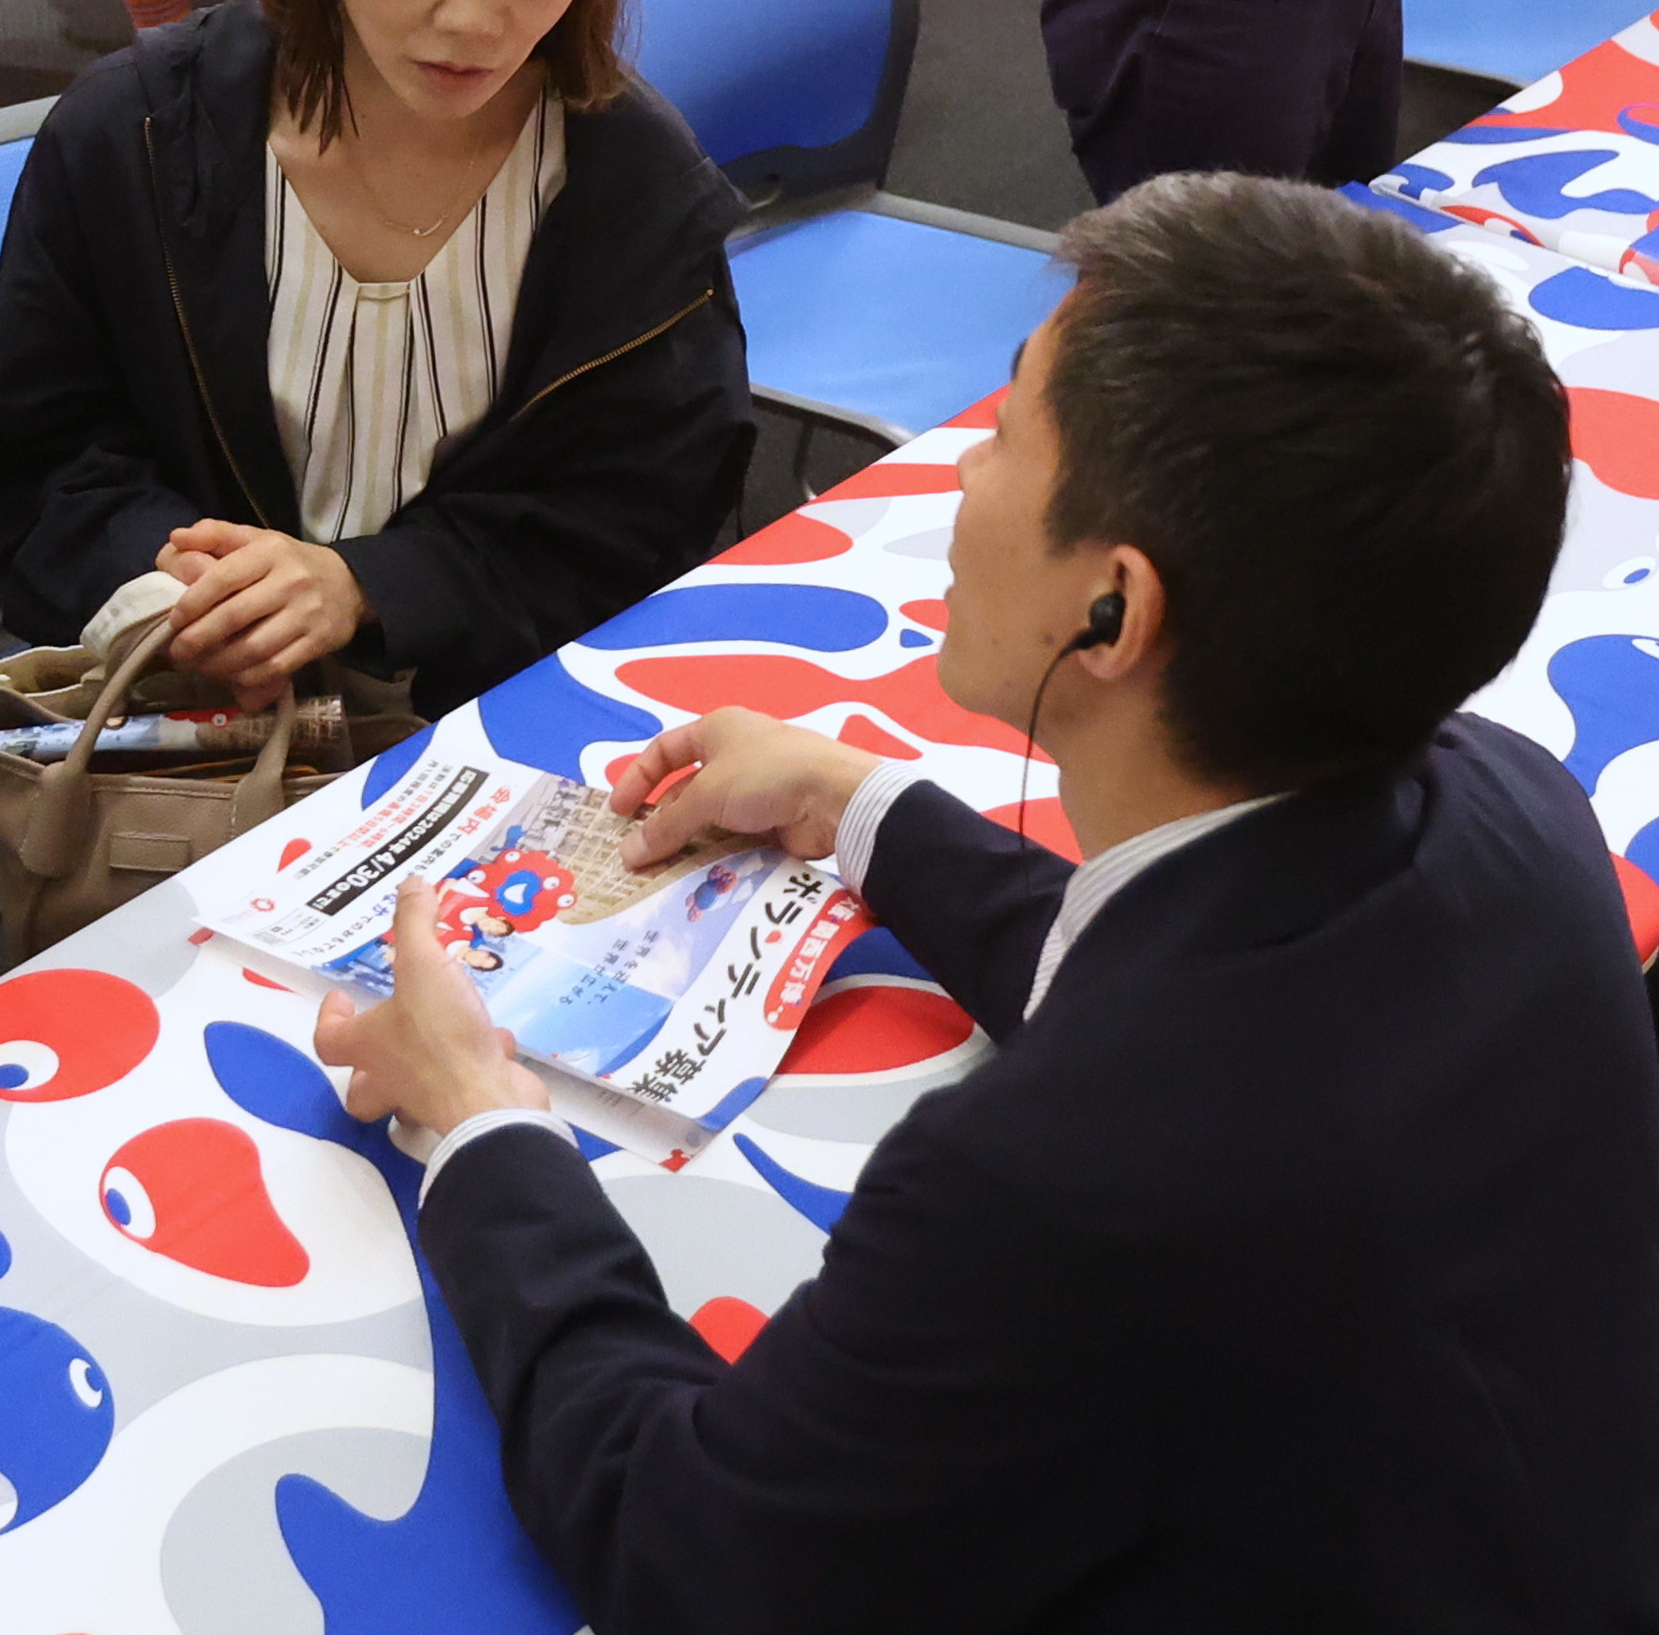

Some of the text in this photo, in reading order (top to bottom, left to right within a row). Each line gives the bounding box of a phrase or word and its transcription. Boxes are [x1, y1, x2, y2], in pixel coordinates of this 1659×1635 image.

[625, 871, 823, 1103] ボランティア募集
